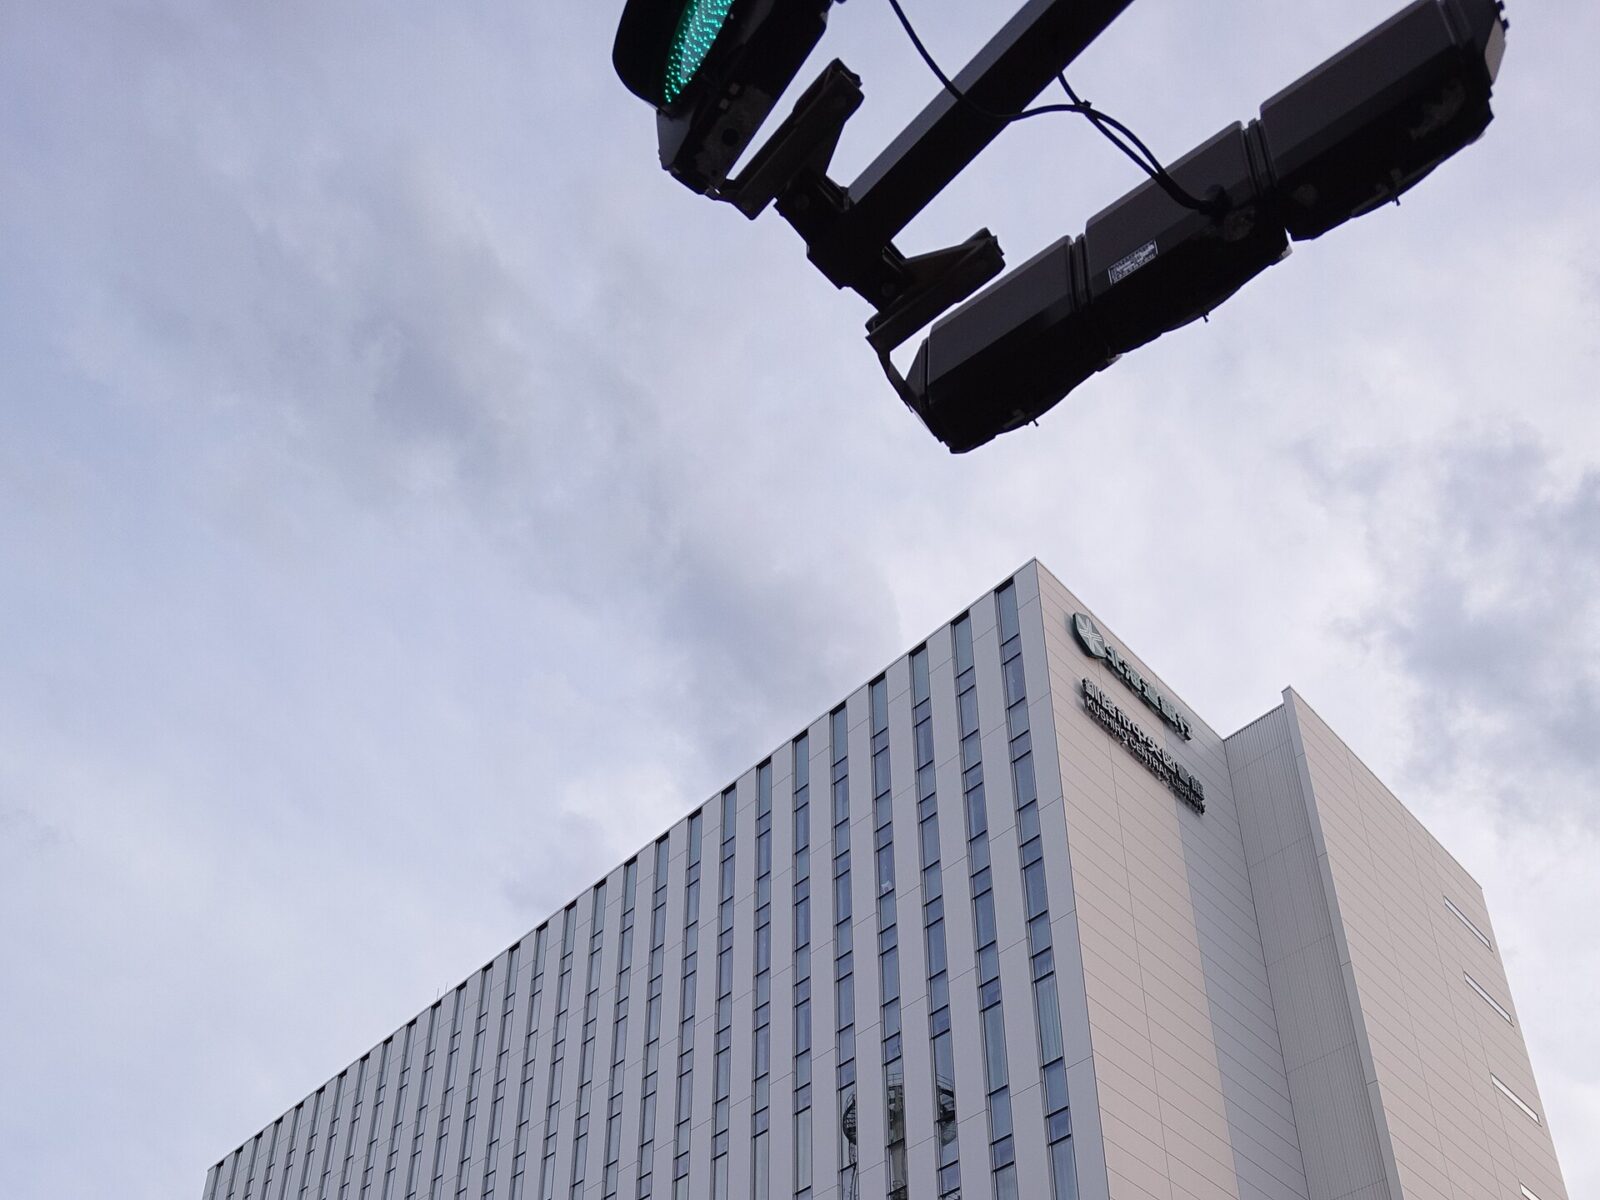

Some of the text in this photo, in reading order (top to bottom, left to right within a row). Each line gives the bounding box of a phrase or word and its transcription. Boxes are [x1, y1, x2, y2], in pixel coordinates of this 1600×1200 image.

[1086, 696, 1206, 814] KUSHIRO CENTRAL LIBRARY
